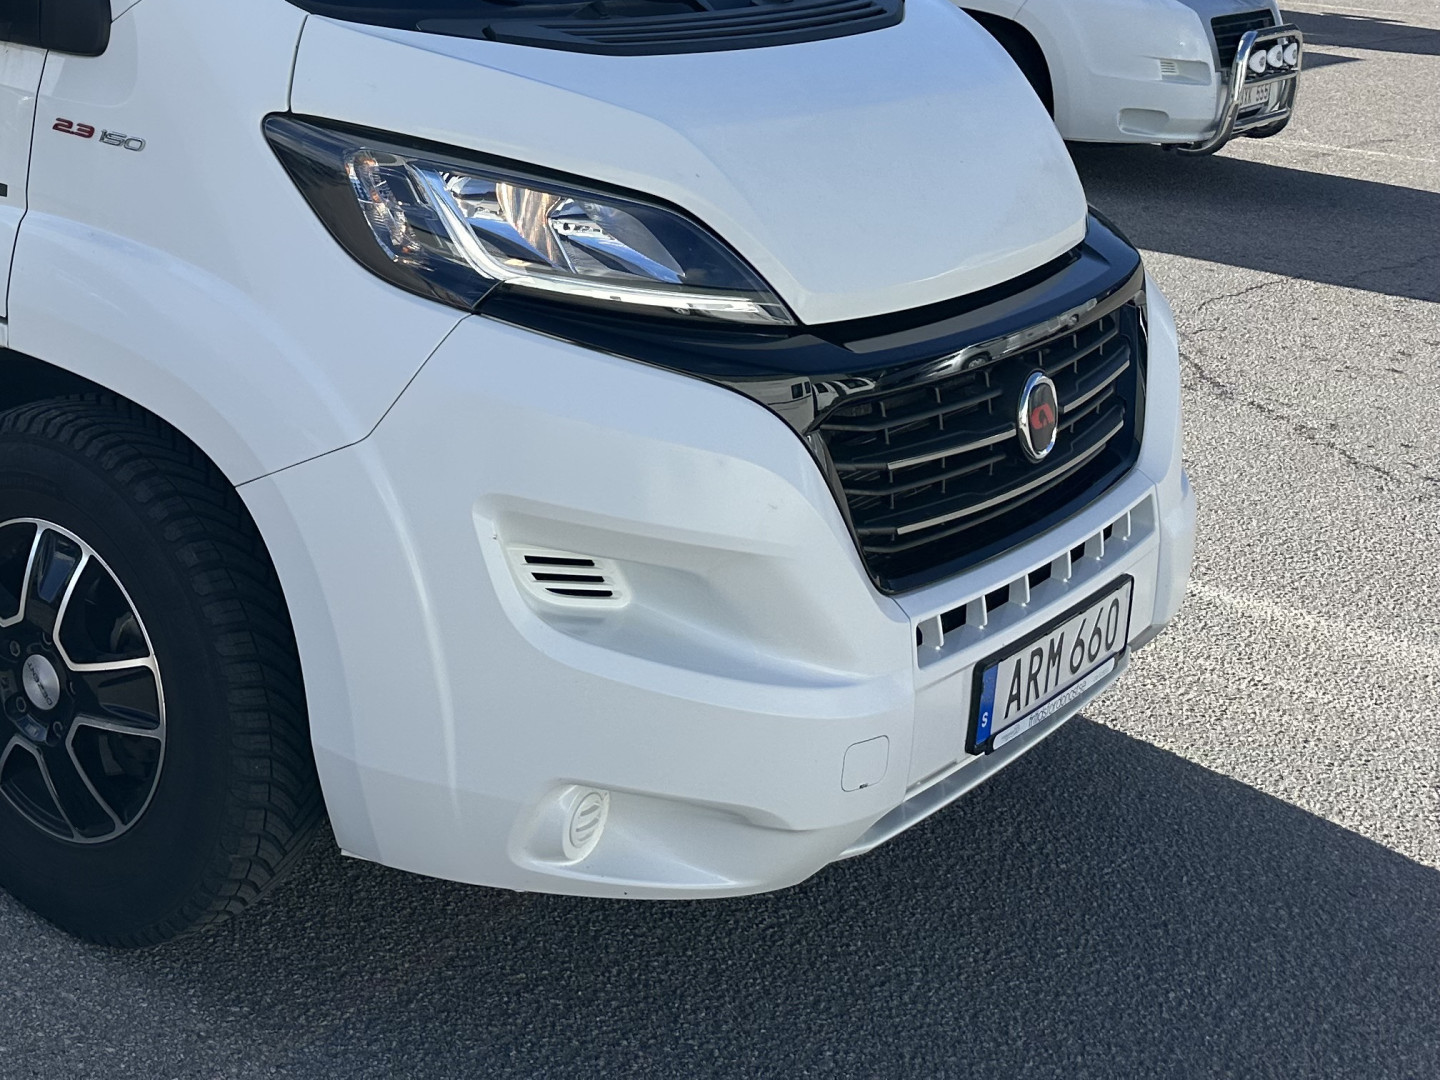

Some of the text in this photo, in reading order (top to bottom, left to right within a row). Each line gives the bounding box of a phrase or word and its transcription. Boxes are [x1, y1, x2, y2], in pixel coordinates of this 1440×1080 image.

[52, 117, 147, 152] 2.3 150
[981, 711, 988, 728] S
[1004, 631, 1064, 720] ARM
[1069, 597, 1120, 675] 660
